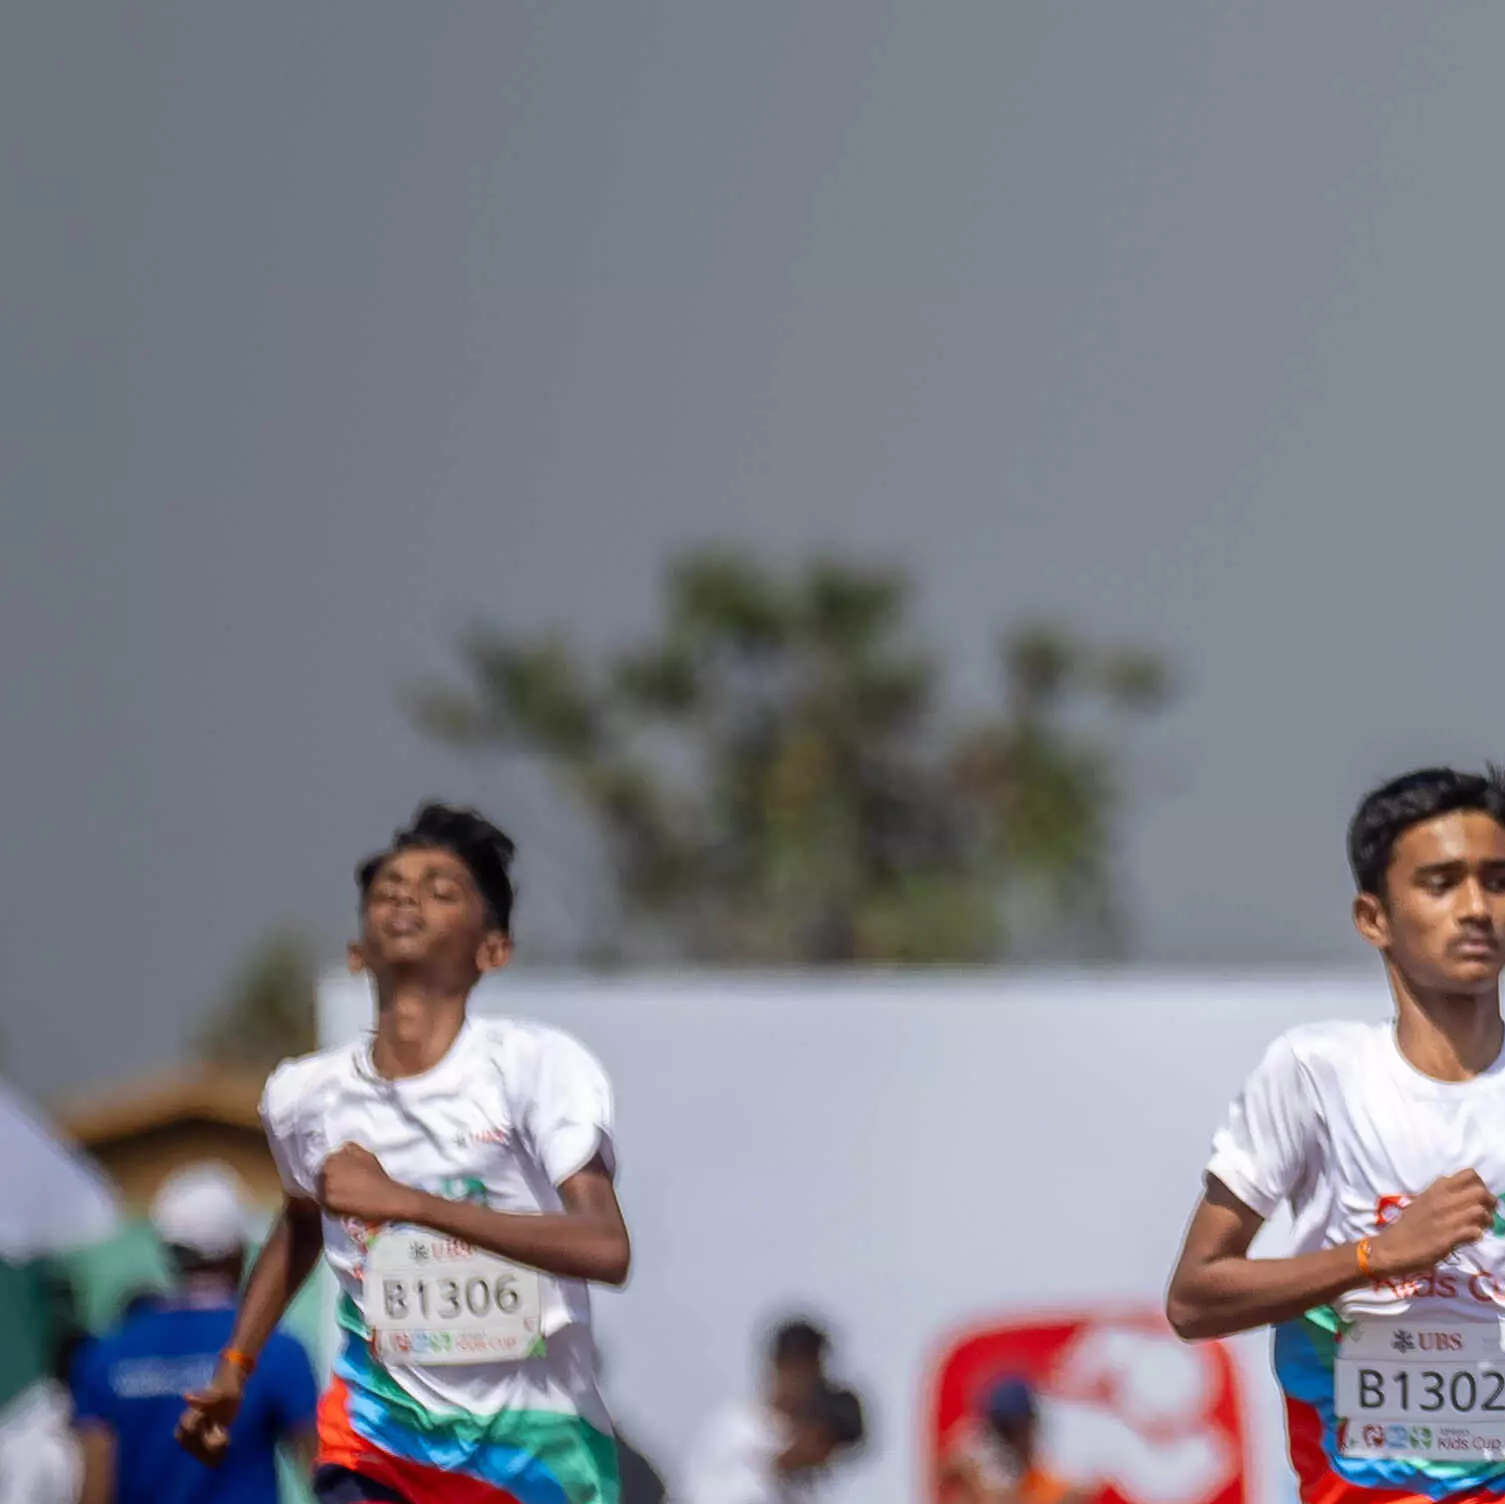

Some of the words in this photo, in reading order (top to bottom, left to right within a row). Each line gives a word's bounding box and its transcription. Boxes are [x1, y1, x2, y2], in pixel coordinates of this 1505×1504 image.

[383, 1274, 521, 1319] B1306
[1418, 1332, 1463, 1351] UBS
[1359, 1369, 1505, 1412] B1302
